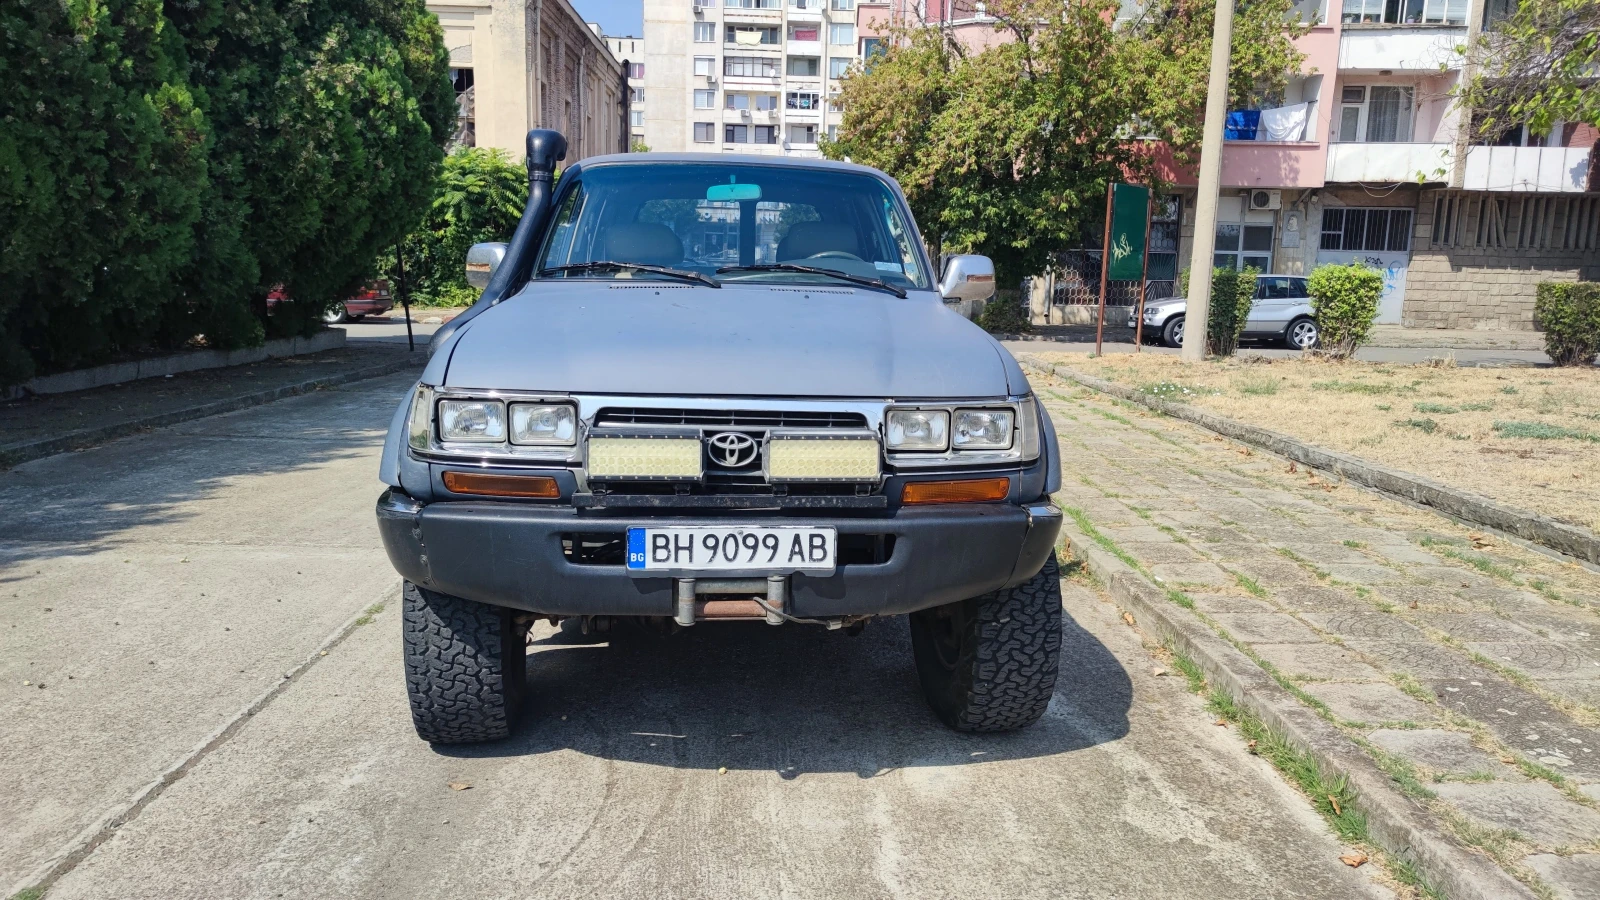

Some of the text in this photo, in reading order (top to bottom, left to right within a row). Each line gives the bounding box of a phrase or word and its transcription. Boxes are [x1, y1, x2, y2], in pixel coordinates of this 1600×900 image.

[630, 553, 644, 562] BG
[652, 533, 828, 563] BH 9099 AB
